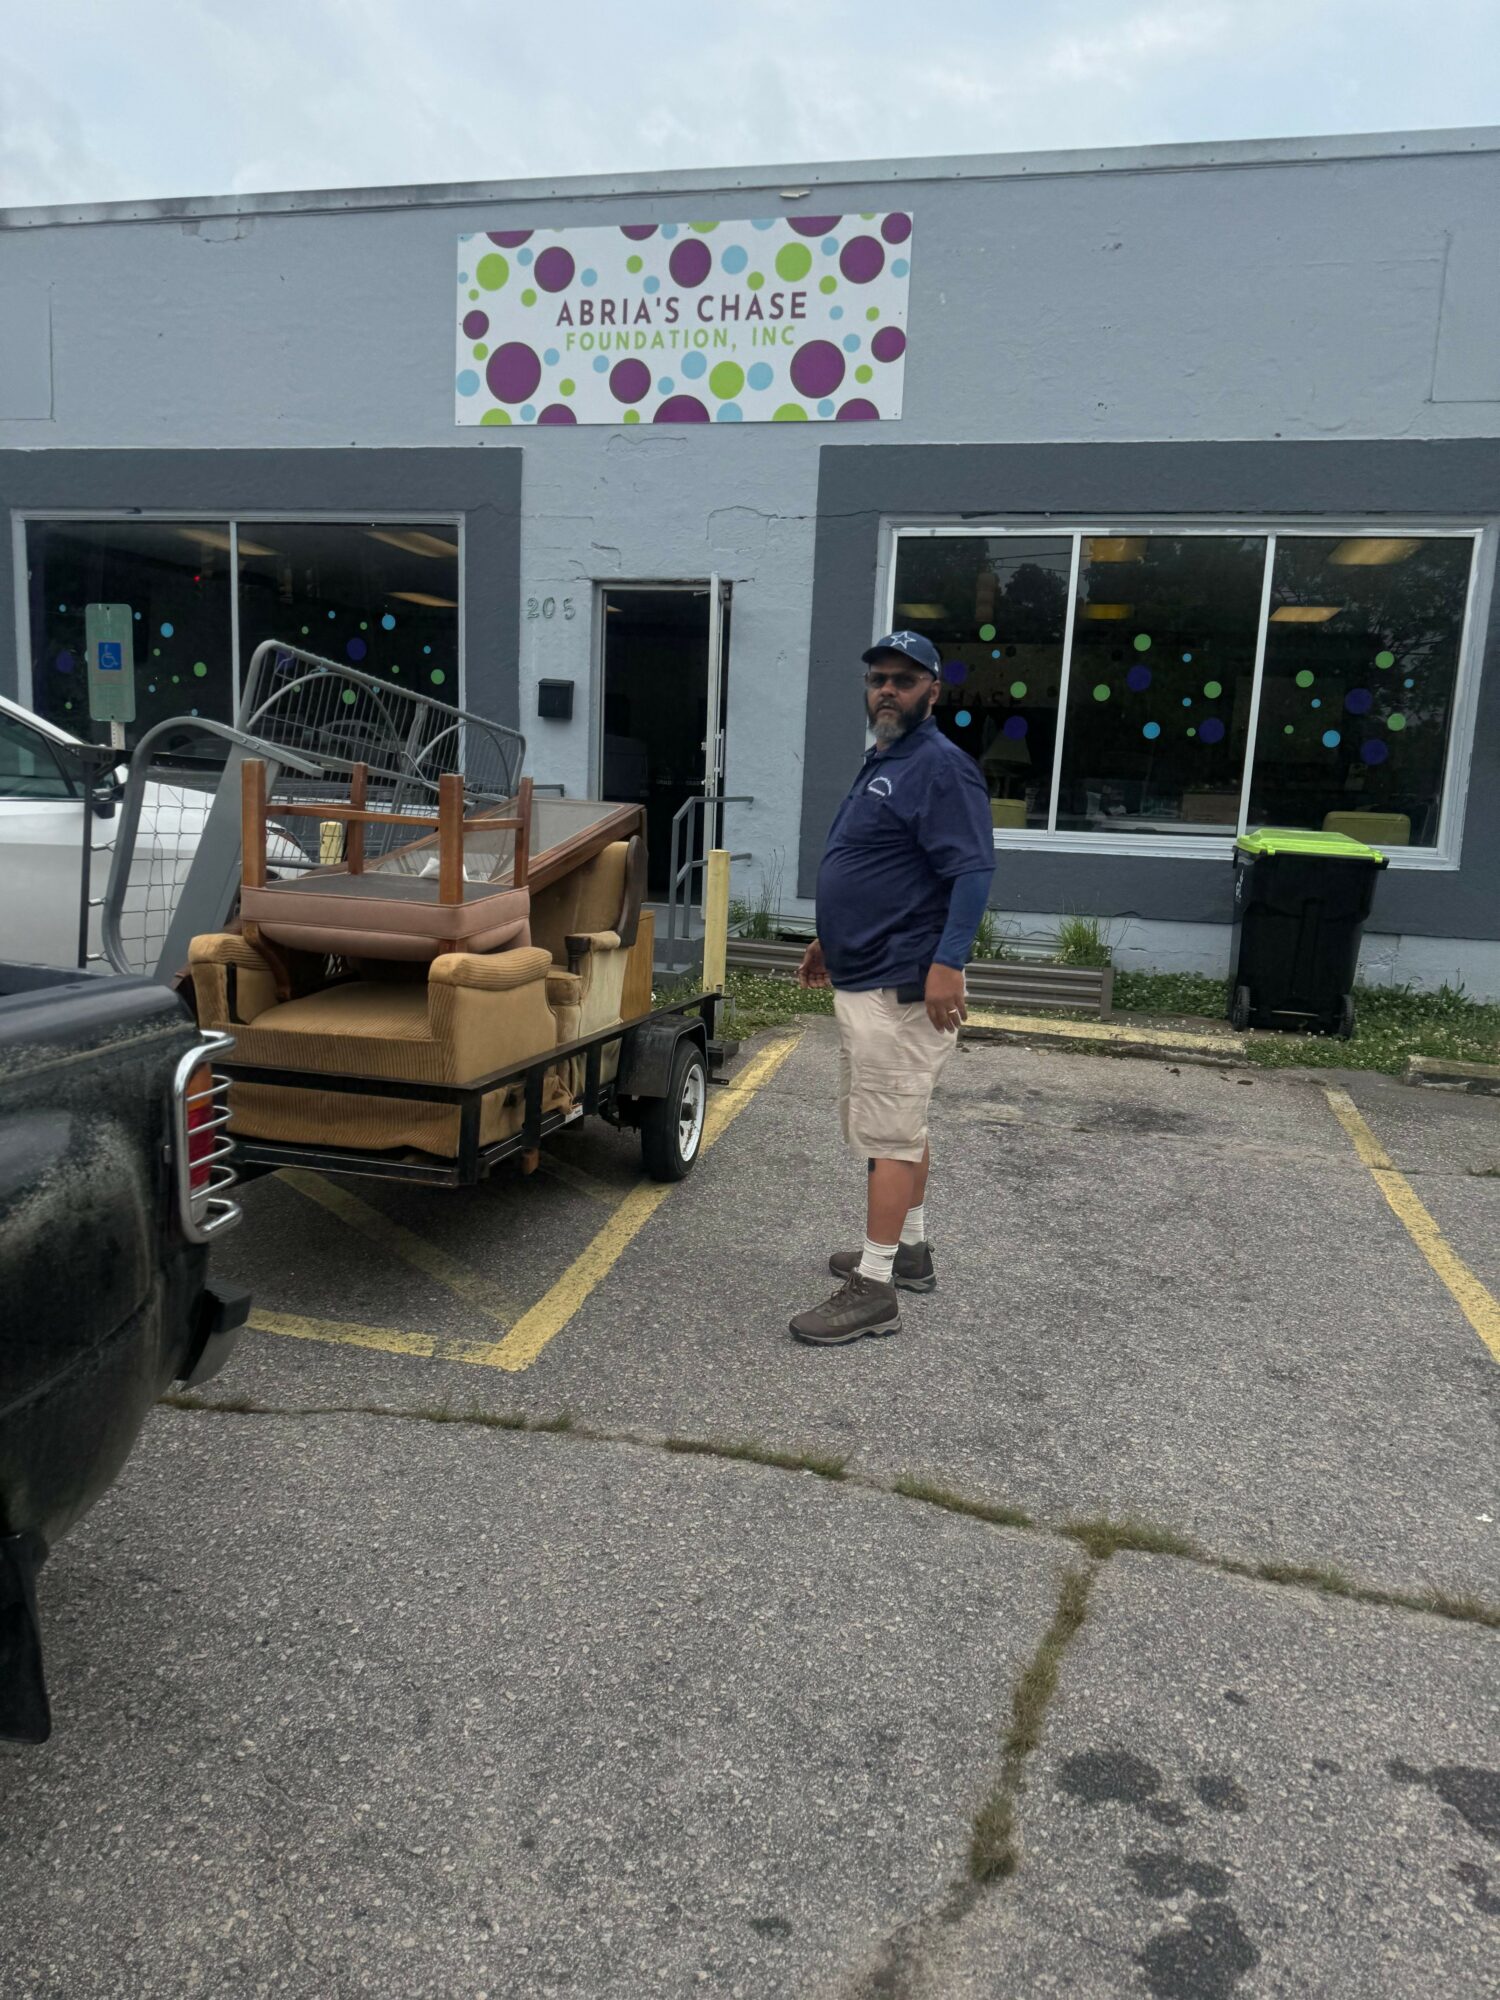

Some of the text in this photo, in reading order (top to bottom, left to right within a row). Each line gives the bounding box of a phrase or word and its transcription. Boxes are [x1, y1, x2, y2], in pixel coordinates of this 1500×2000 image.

[557, 292, 807, 327] ABRIA'S CHASE
[566, 325, 796, 352] FOUNDATION, INC
[527, 597, 576, 621] 205
